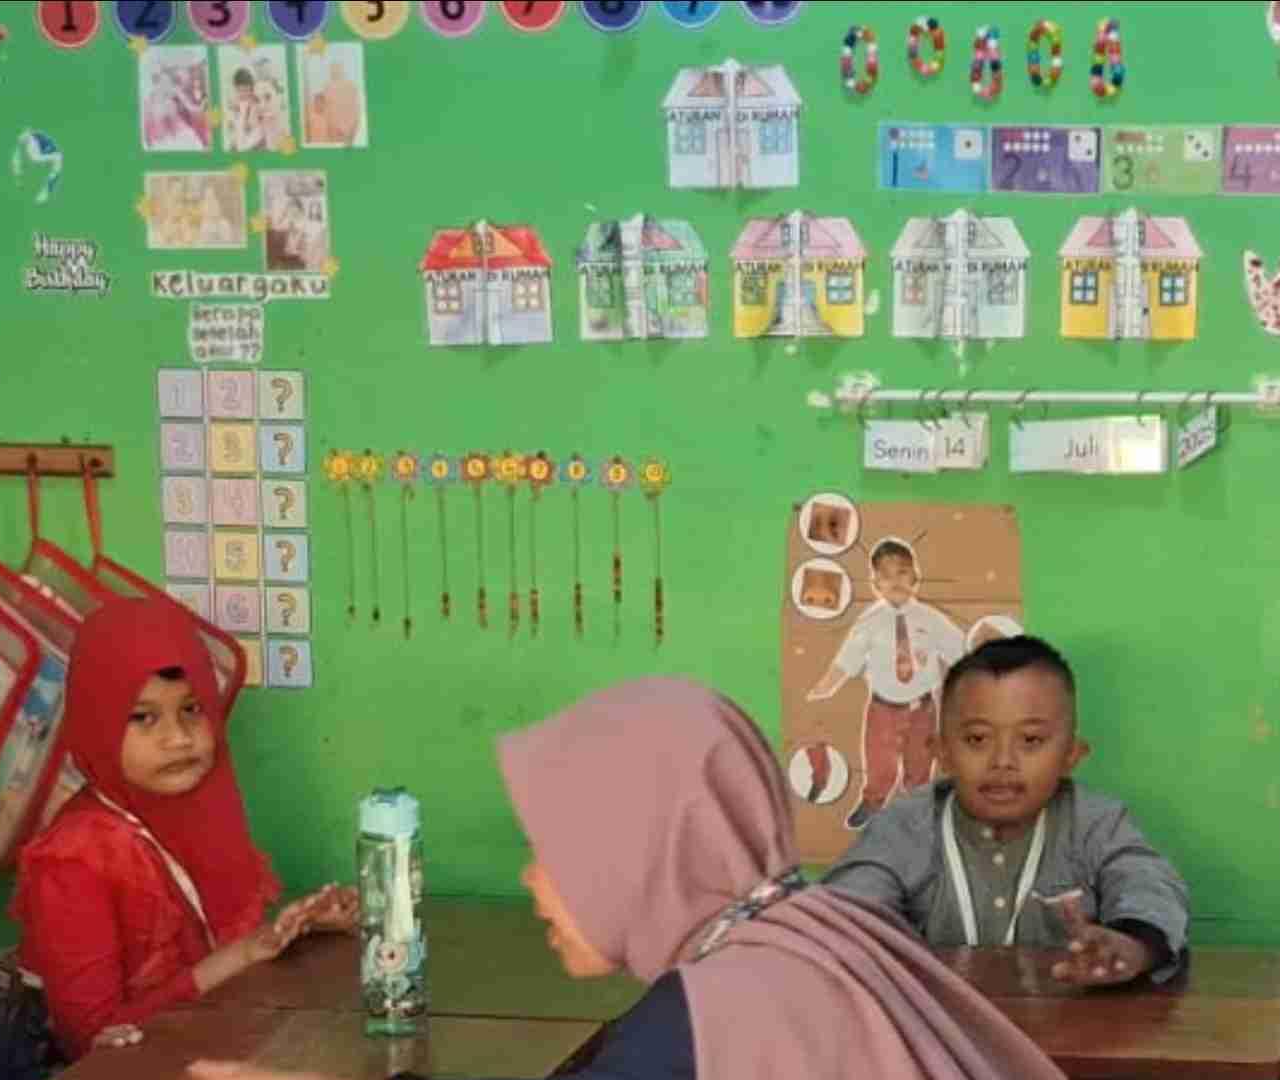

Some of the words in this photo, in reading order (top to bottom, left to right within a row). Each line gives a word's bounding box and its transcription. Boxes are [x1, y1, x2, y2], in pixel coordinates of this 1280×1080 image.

[61, 0, 77, 32] 1
[1000, 152, 1021, 190] 2
[1112, 155, 1135, 191] 3
[1229, 156, 1252, 190] 4
[271, 376, 295, 412] ?
[273, 431, 295, 466] ?
[873, 438, 931, 461] Senin
[944, 437, 966, 457] 14
[1064, 437, 1100, 460] Juli
[273, 486, 296, 521] ?
[275, 539, 297, 573] ?
[276, 592, 297, 627] ?
[278, 644, 299, 680] ?
